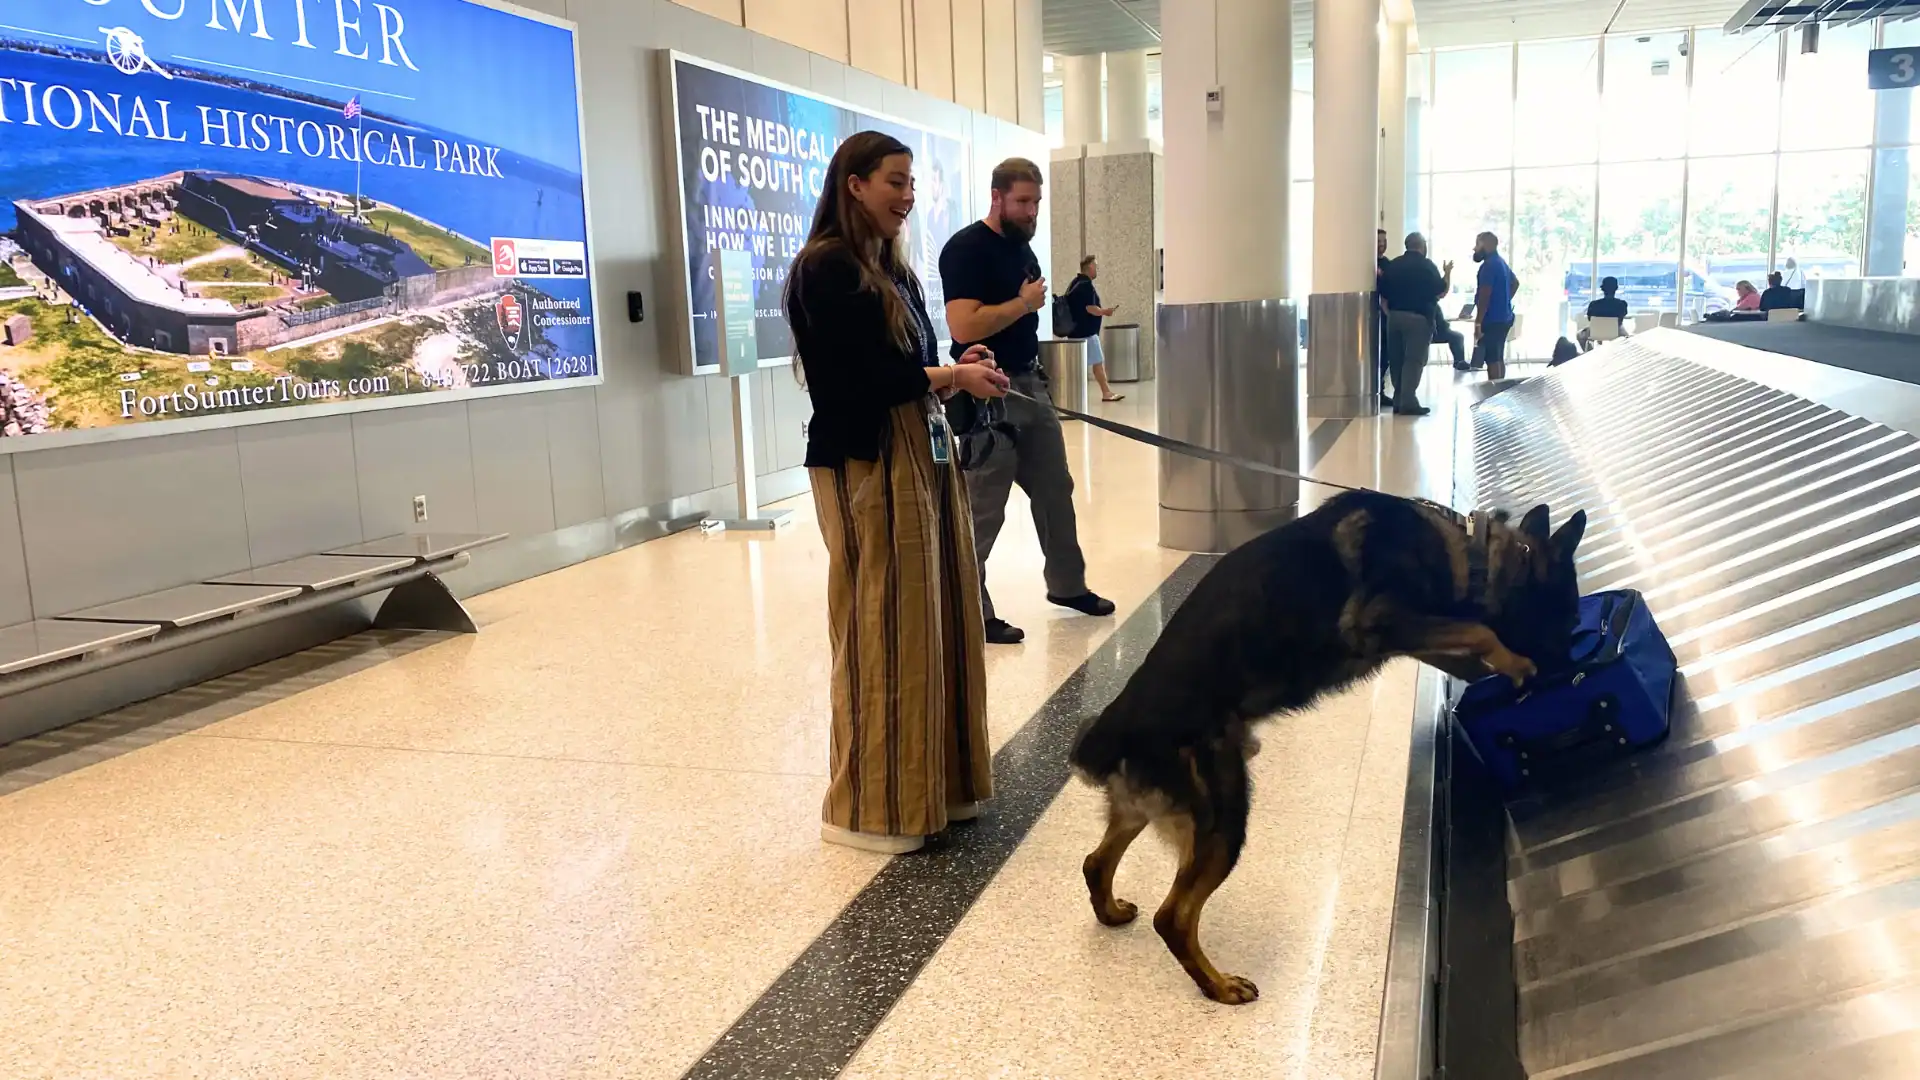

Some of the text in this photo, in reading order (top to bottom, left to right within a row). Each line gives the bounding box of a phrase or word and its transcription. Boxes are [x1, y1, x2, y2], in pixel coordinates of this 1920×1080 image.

[82, 0, 419, 71] MTER
[1888, 53, 1916, 83] 3
[196, 105, 426, 169] HISTORICAL
[432, 139, 504, 178] PARK
[696, 104, 830, 165] THE MEDICAL
[700, 146, 732, 184] OF
[738, 152, 804, 196] SOUTH
[703, 204, 803, 236] INNOVATION
[706, 231, 805, 258] HOW WE LEA
[532, 297, 581, 309] Authorized
[533, 314, 591, 326] Concessioner
[118, 375, 390, 418] FortSumterTours.com
[547, 354, 594, 381] [2628]
